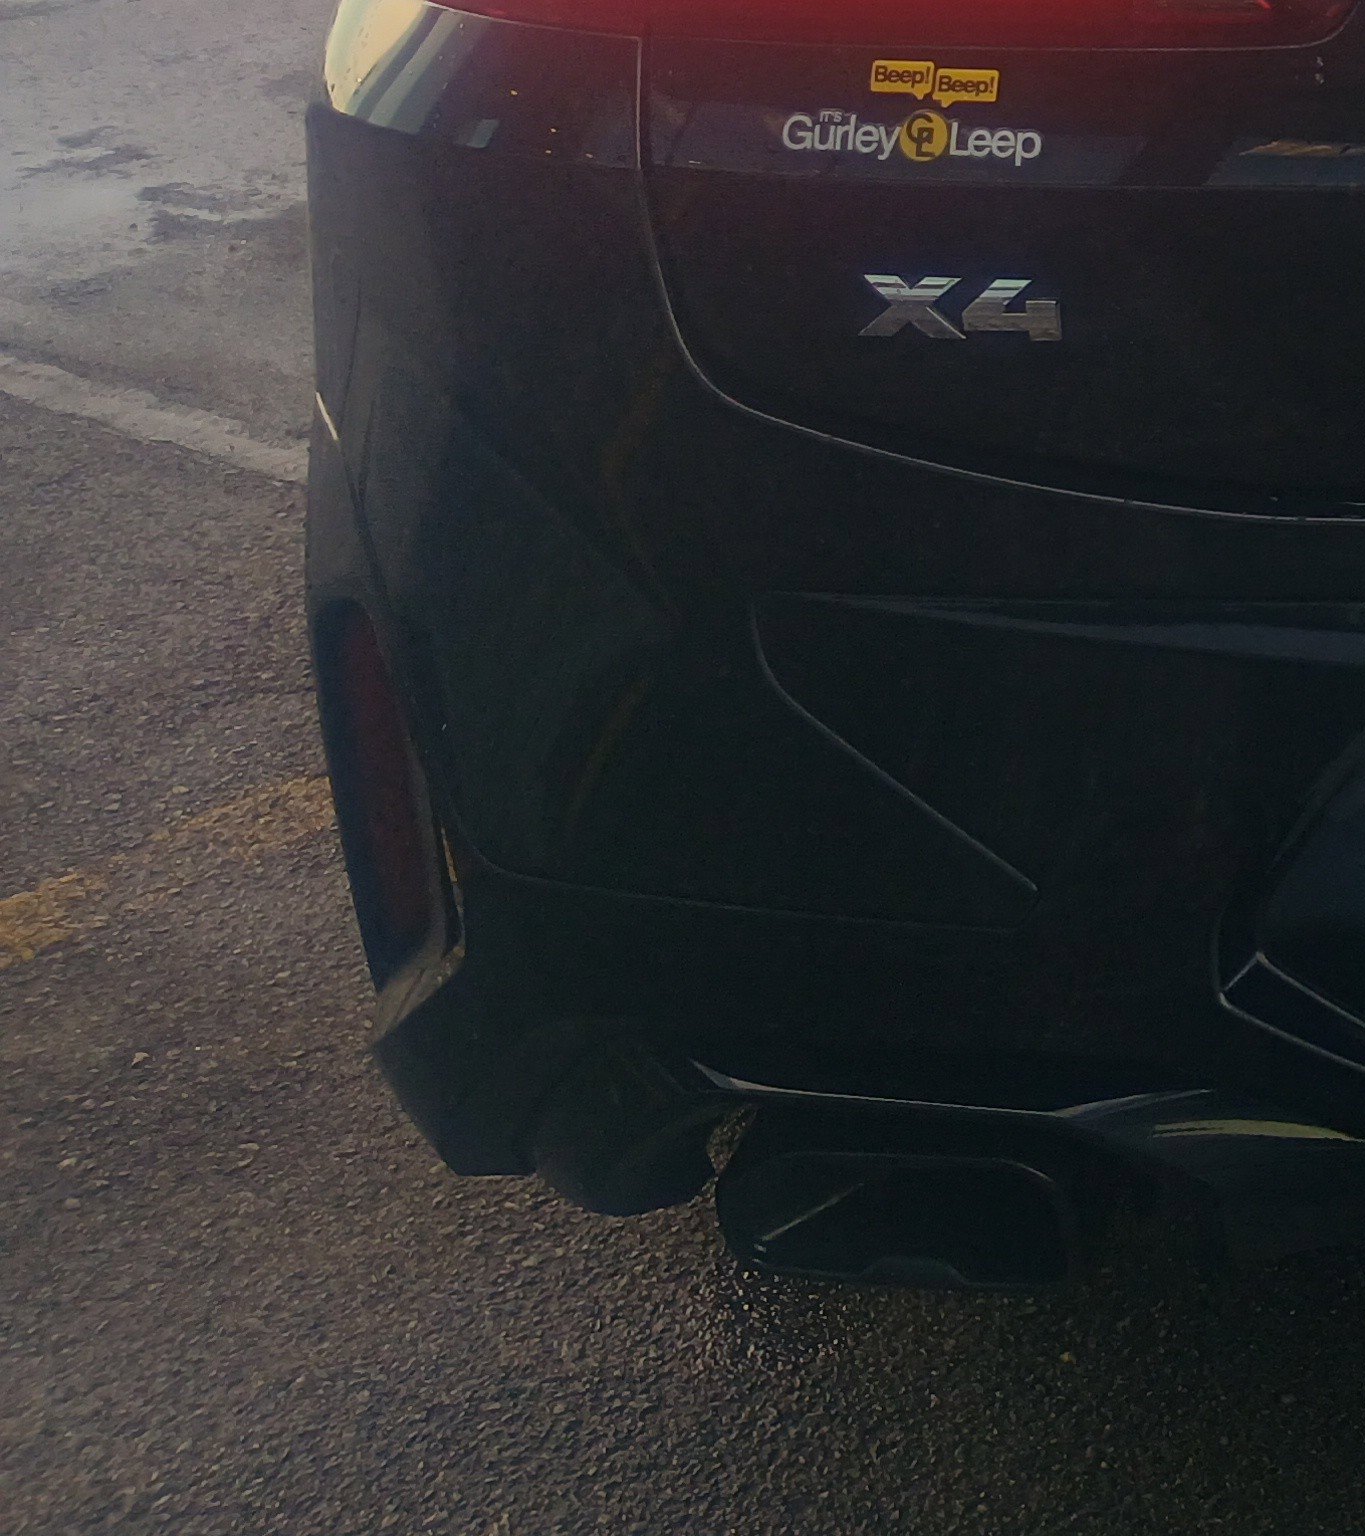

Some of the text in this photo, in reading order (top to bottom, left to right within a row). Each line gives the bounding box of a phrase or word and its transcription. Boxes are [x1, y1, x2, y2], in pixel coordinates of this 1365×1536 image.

[873, 64, 996, 97] Beep! Beep!
[782, 114, 902, 161] Gurley
[949, 121, 1042, 167] Leep
[857, 273, 1063, 343] X4
